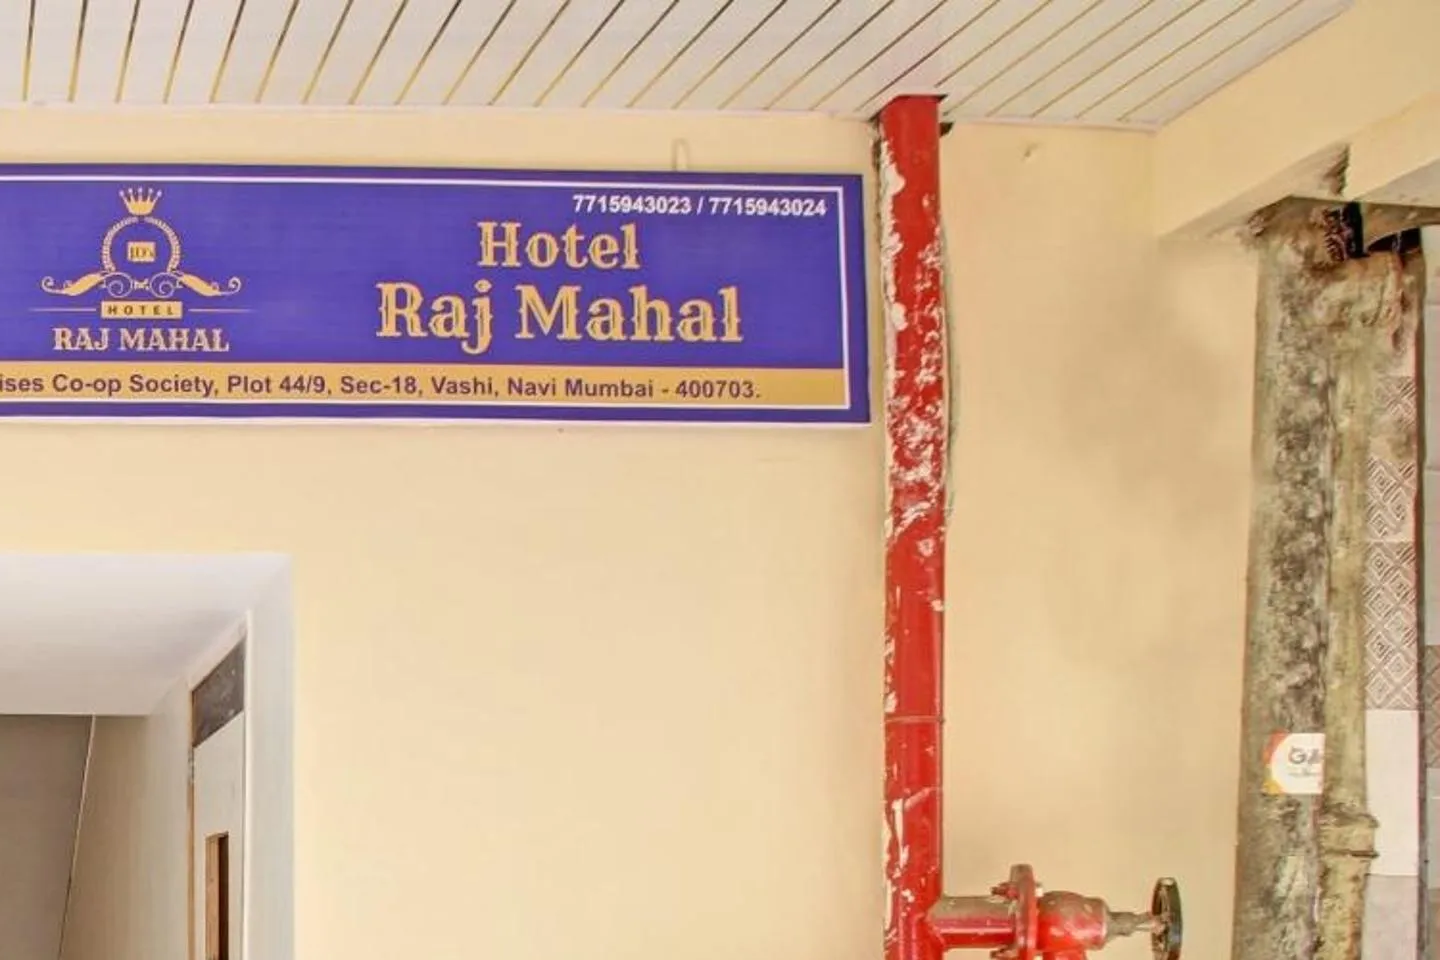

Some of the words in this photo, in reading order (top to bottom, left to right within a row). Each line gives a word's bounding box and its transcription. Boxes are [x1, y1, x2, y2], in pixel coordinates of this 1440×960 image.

[573, 194, 692, 215] 7715943023
[697, 196, 703, 216] /
[709, 197, 828, 217] 7715943024
[477, 221, 640, 269] Hotel
[107, 304, 176, 316] HOTEL
[375, 279, 493, 355] Raj
[515, 284, 744, 342] Mahal
[52, 326, 109, 351] RAJ
[119, 327, 229, 353] MAHAL
[52, 373, 122, 395] Co-op
[129, 374, 219, 397] Society,
[227, 375, 271, 394] Plot
[279, 375, 332, 397] 44/9,
[340, 376, 423, 397] Sec-18,
[431, 377, 499, 398] Vashi,
[507, 378, 556, 396] Navi
[565, 378, 653, 398] Mumbai
[675, 380, 761, 399] 400703.
